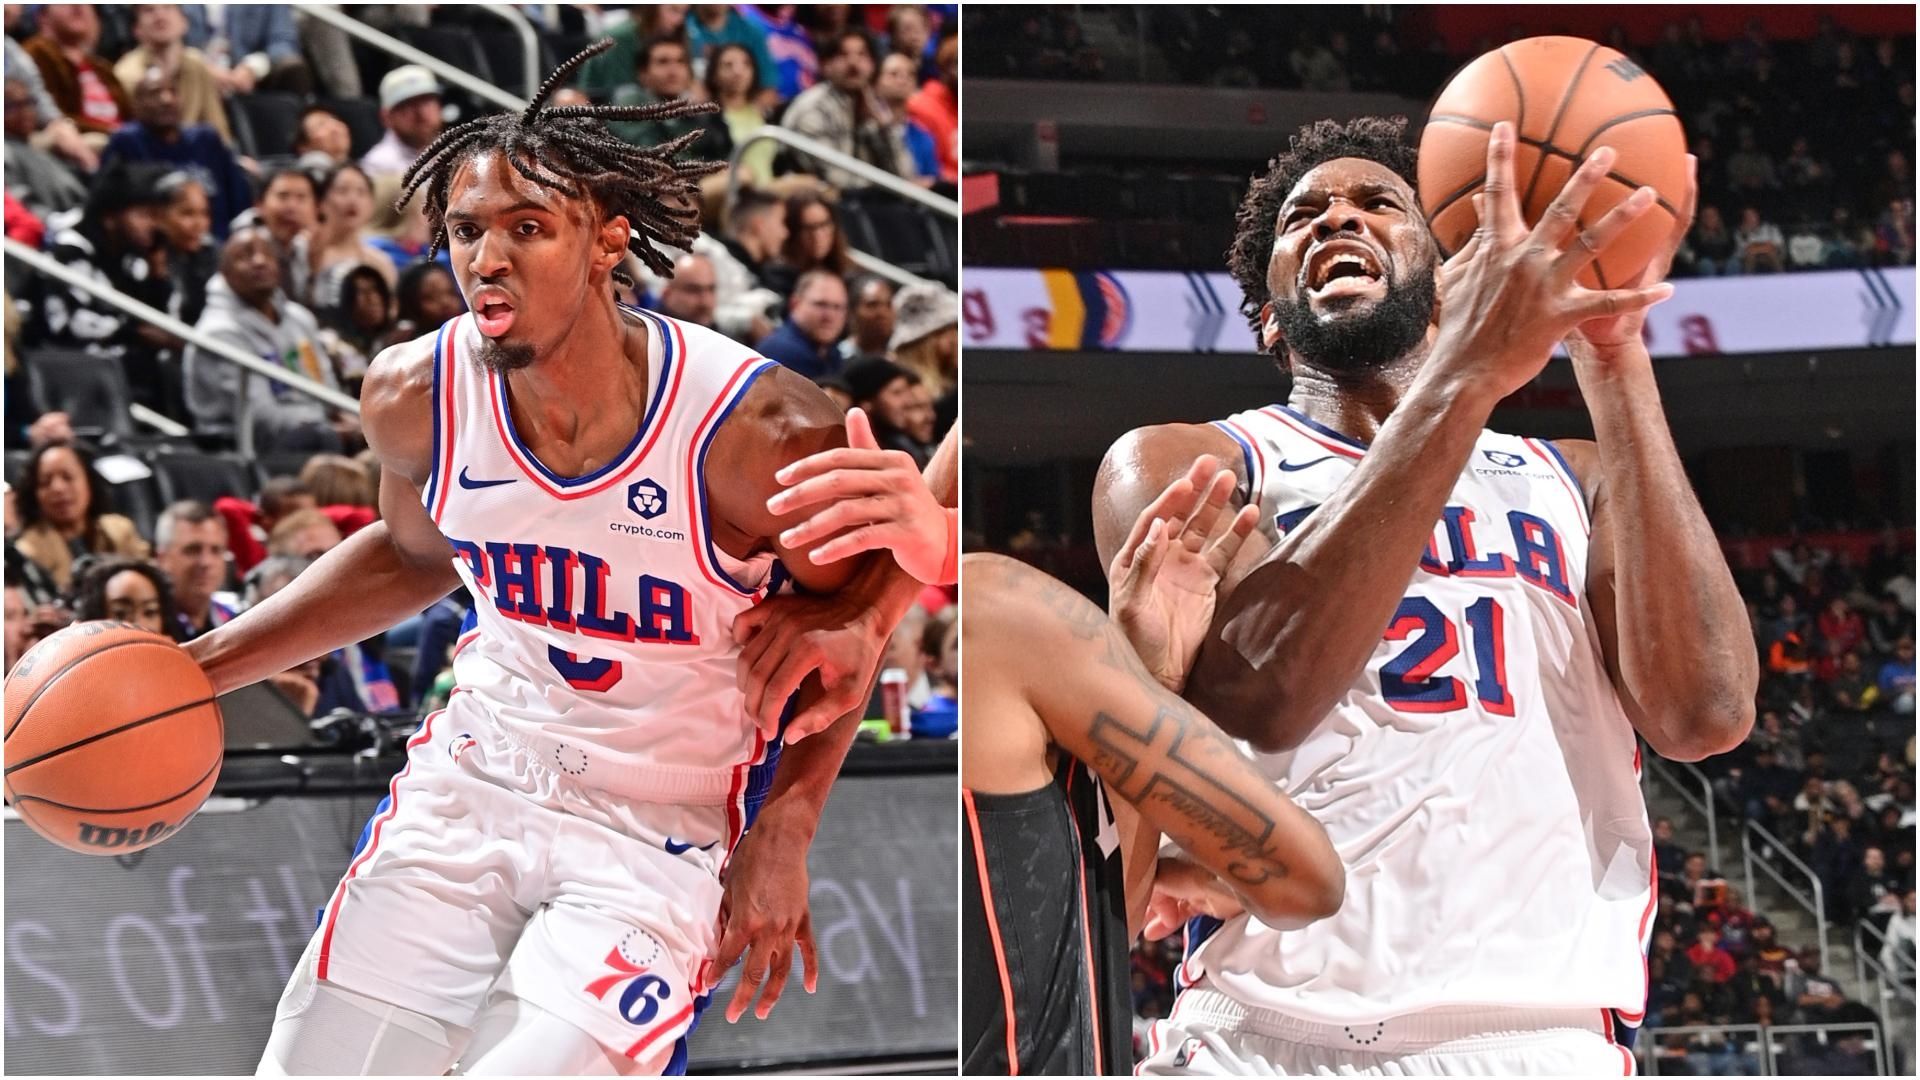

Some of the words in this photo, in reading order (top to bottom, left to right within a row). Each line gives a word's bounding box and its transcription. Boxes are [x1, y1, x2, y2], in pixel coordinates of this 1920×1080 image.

[609, 522, 685, 541] crypto.com
[1379, 595, 1516, 718] 21
[105, 866, 227, 1030] of
[583, 944, 672, 1026] 76
